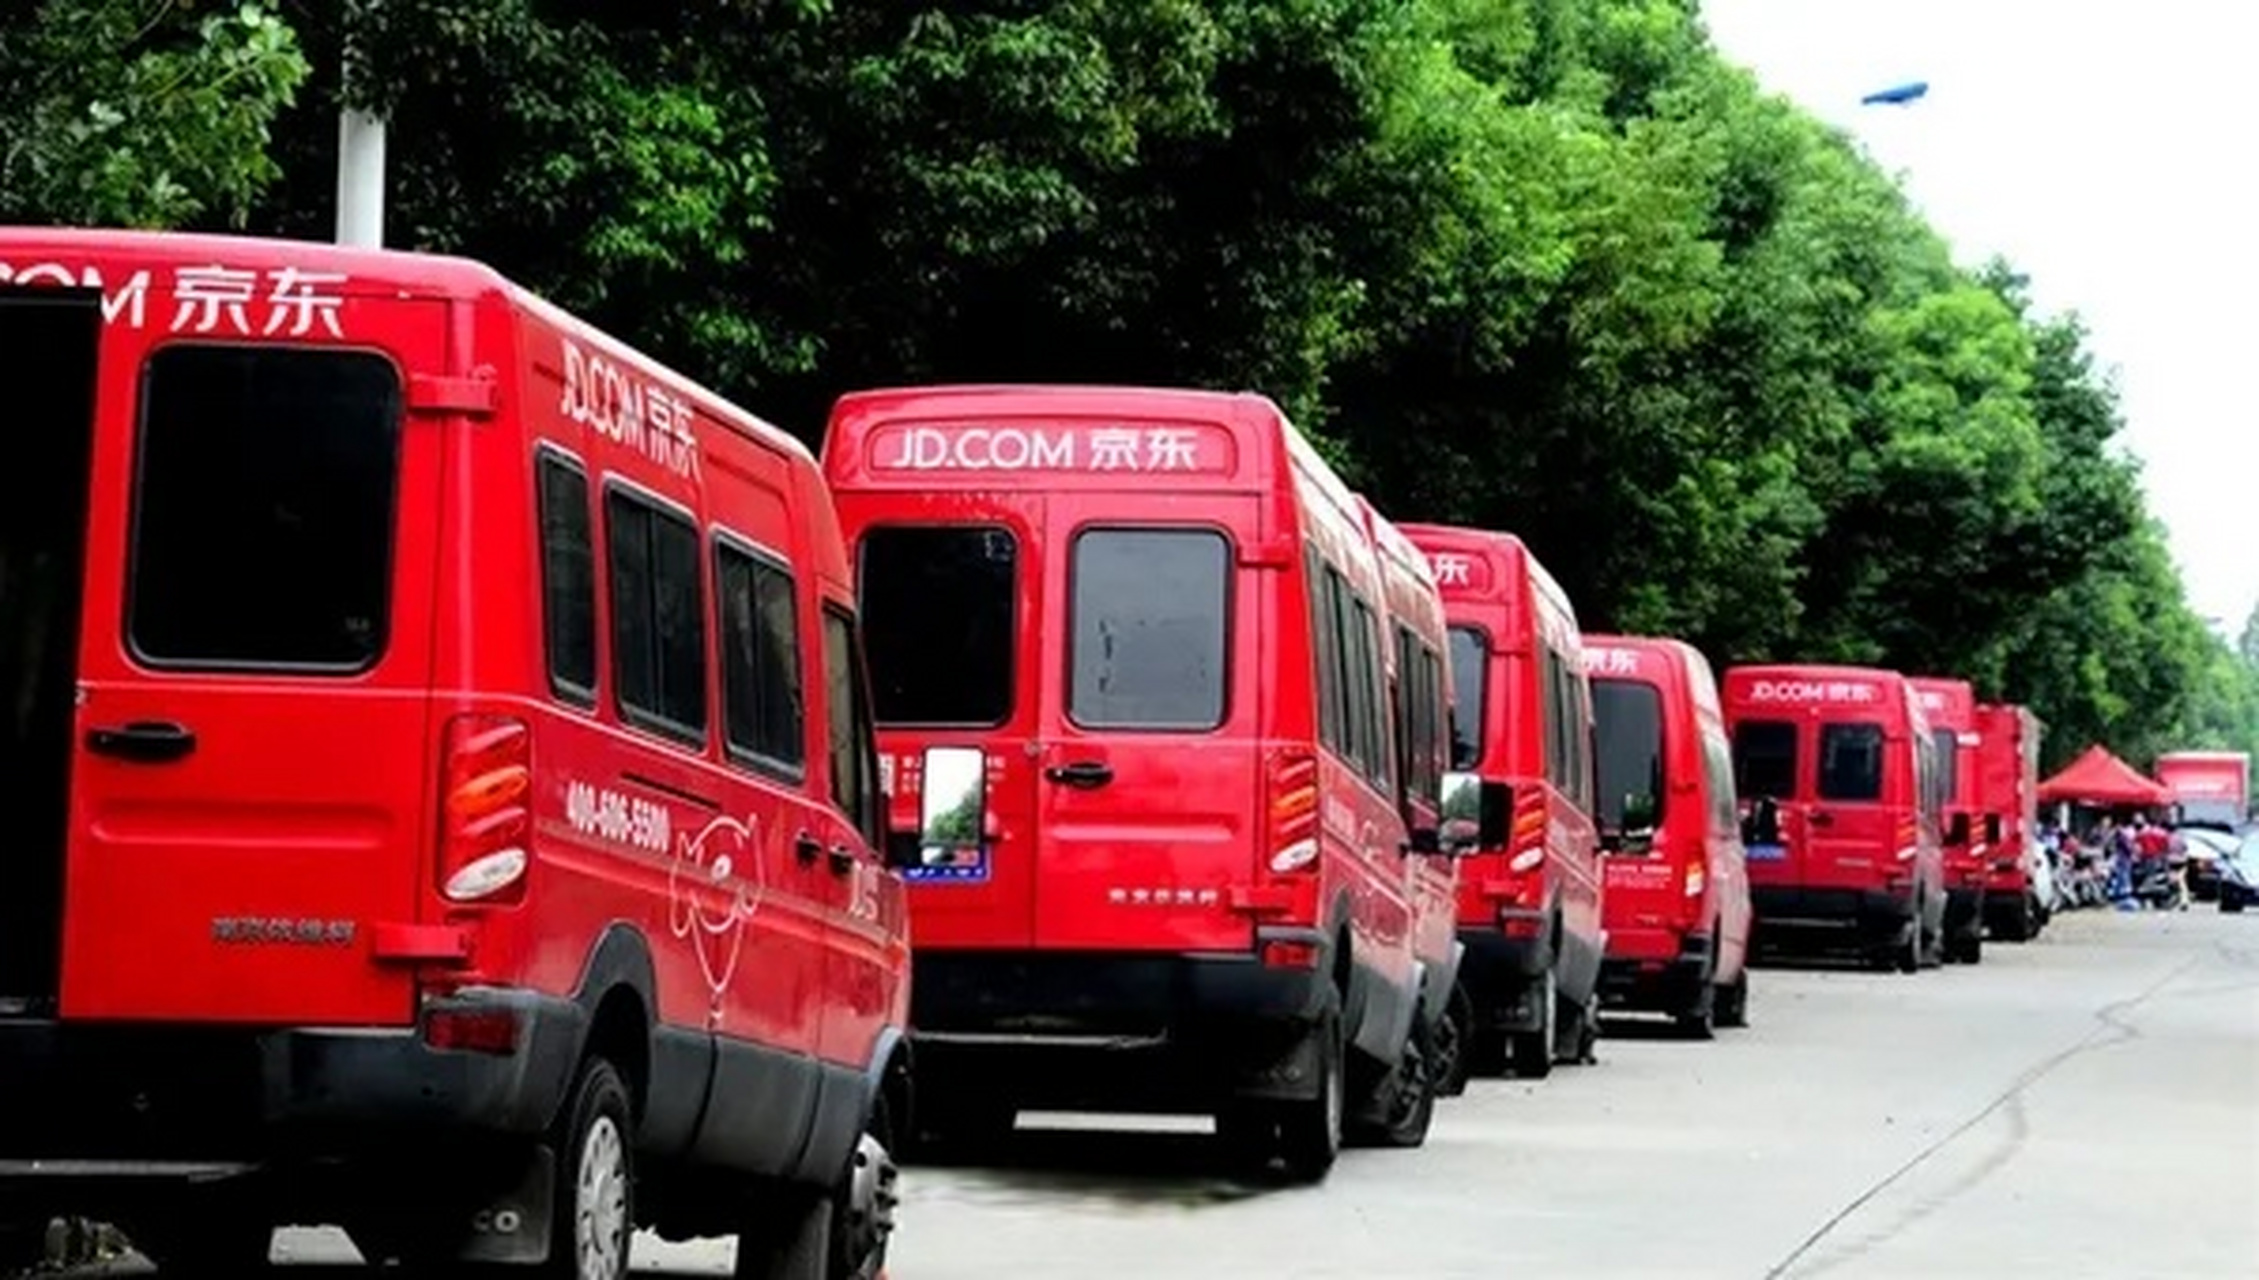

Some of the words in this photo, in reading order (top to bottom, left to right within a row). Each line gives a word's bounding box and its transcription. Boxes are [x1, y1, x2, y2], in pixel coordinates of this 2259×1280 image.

[169, 264, 348, 339] 京东
[646, 386, 702, 484] 京东
[892, 427, 1076, 470] JD.COM
[1088, 427, 1198, 471] 京东
